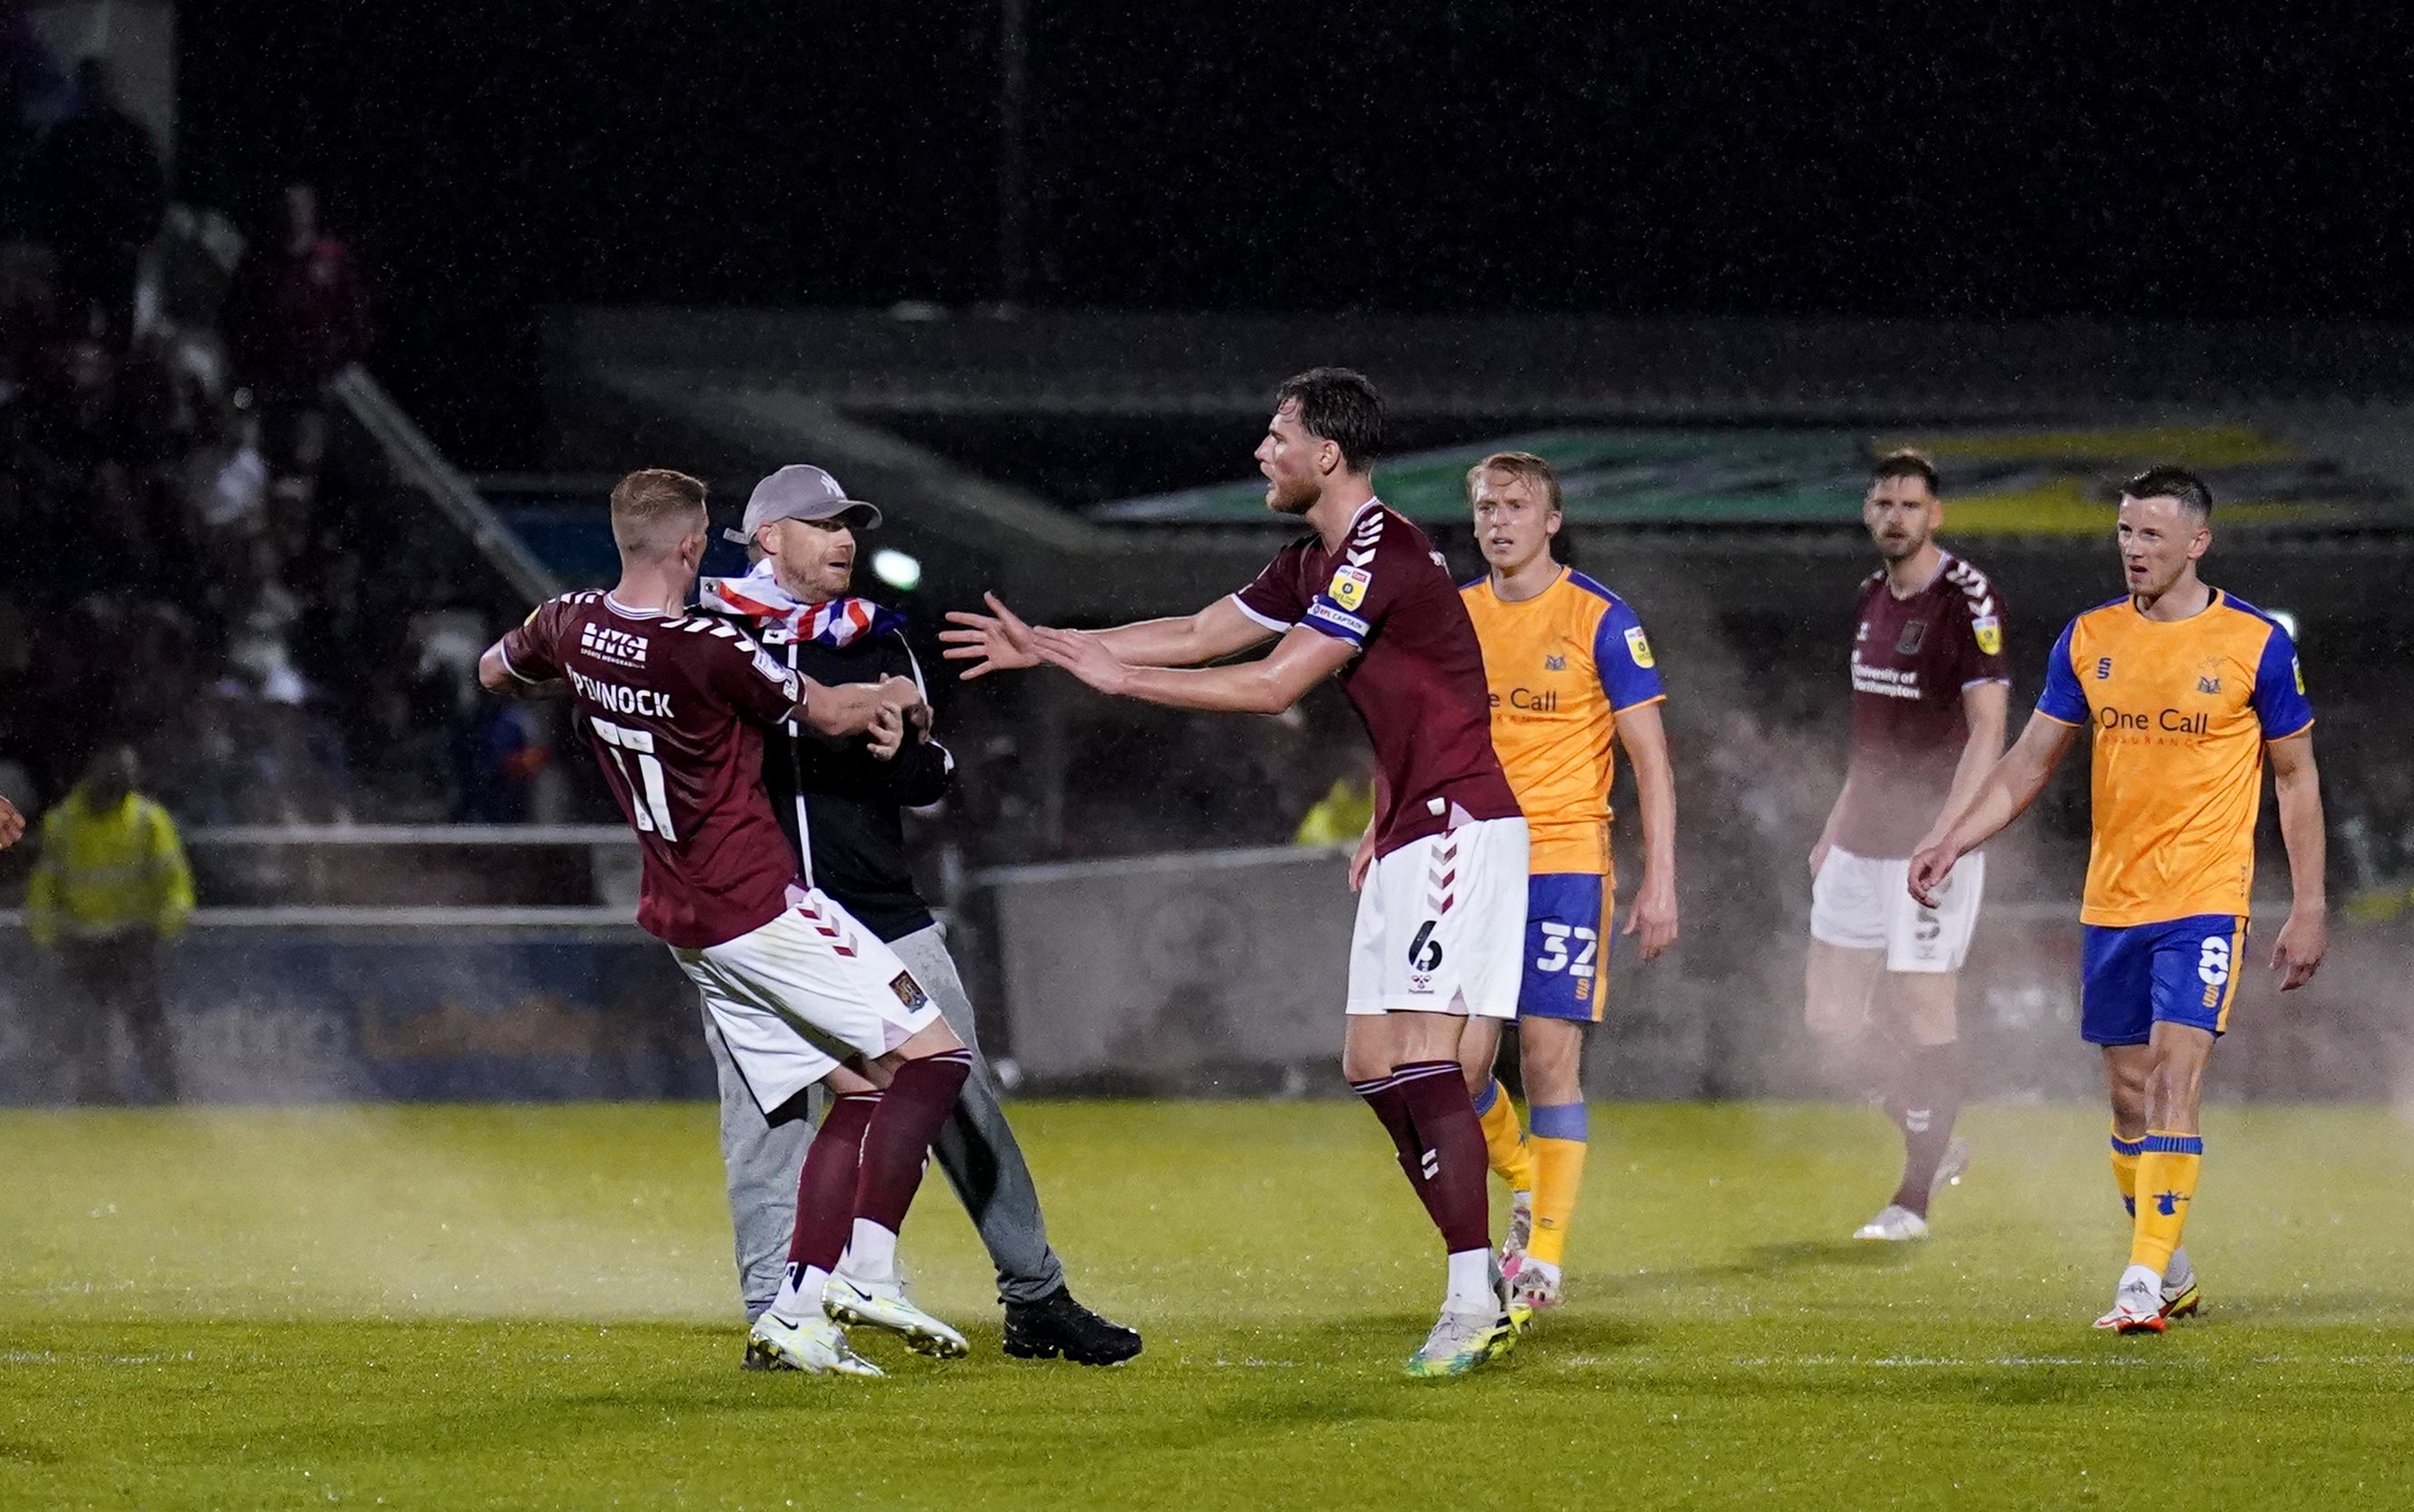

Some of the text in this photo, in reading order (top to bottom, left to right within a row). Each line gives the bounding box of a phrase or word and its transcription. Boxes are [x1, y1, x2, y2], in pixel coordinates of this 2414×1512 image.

[1510, 687, 1556, 712] Call
[2100, 706, 2208, 734] One Call
[1409, 920, 1442, 971] 6
[1537, 921, 1597, 977] 32
[2197, 935, 2229, 986] 8
